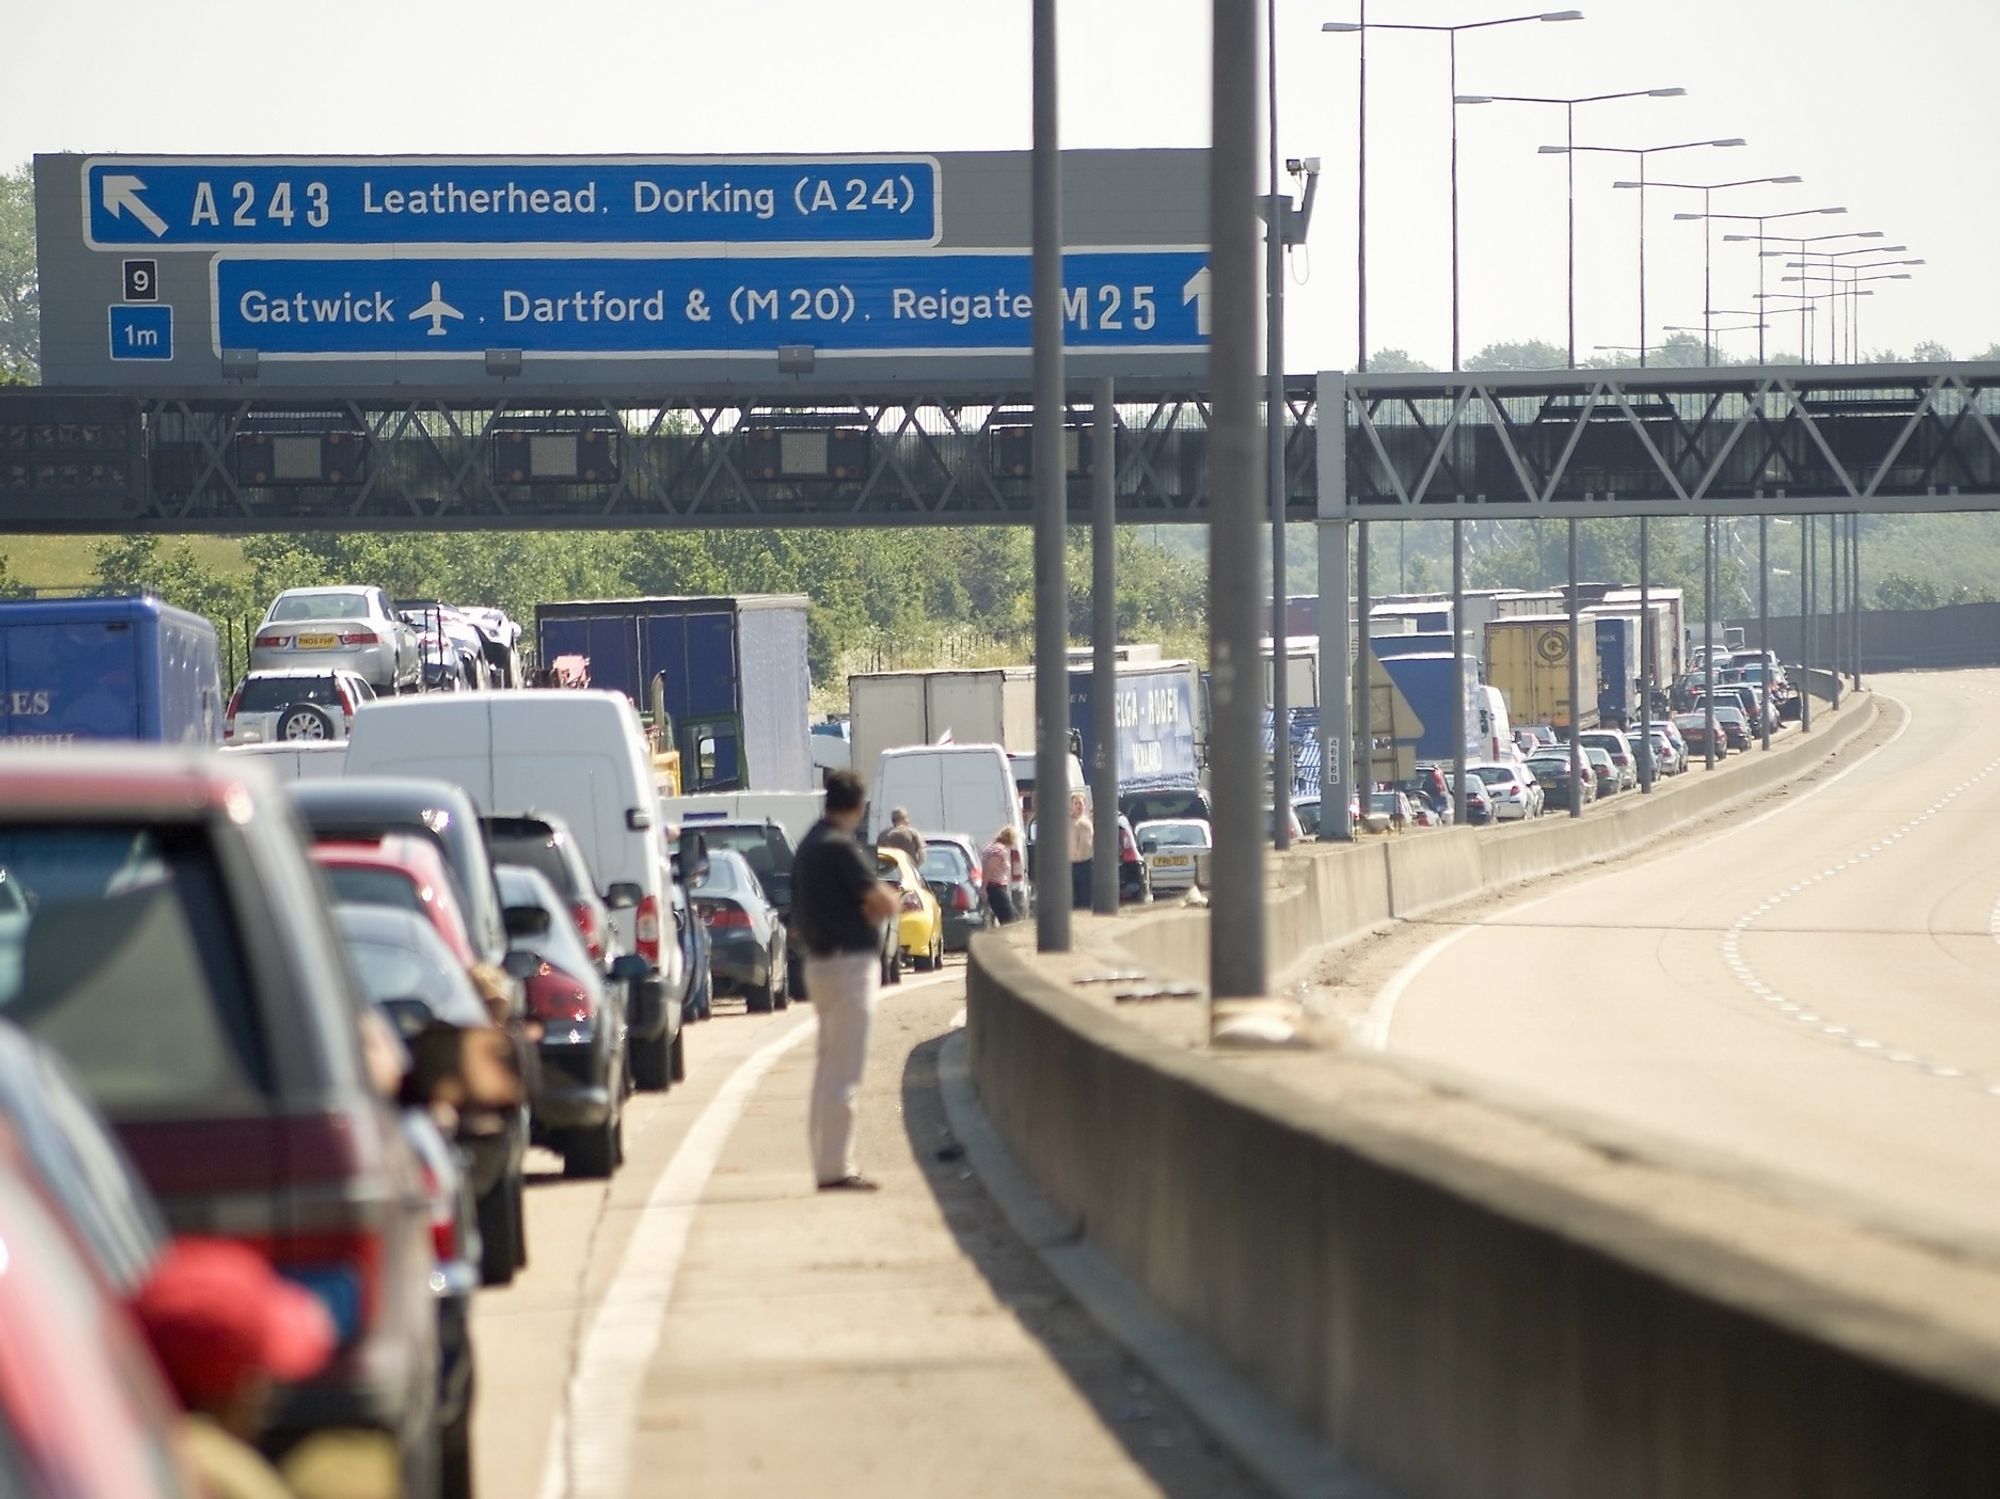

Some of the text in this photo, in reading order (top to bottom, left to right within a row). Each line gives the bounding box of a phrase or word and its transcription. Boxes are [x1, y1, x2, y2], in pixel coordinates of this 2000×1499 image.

[633, 180, 775, 219] Dorking
[133, 269, 149, 292] 9
[239, 289, 395, 323] Gatwick
[503, 288, 665, 322] Dartford
[684, 287, 712, 322] &
[892, 287, 1034, 325] Reigate
[1059, 284, 1156, 331] M25
